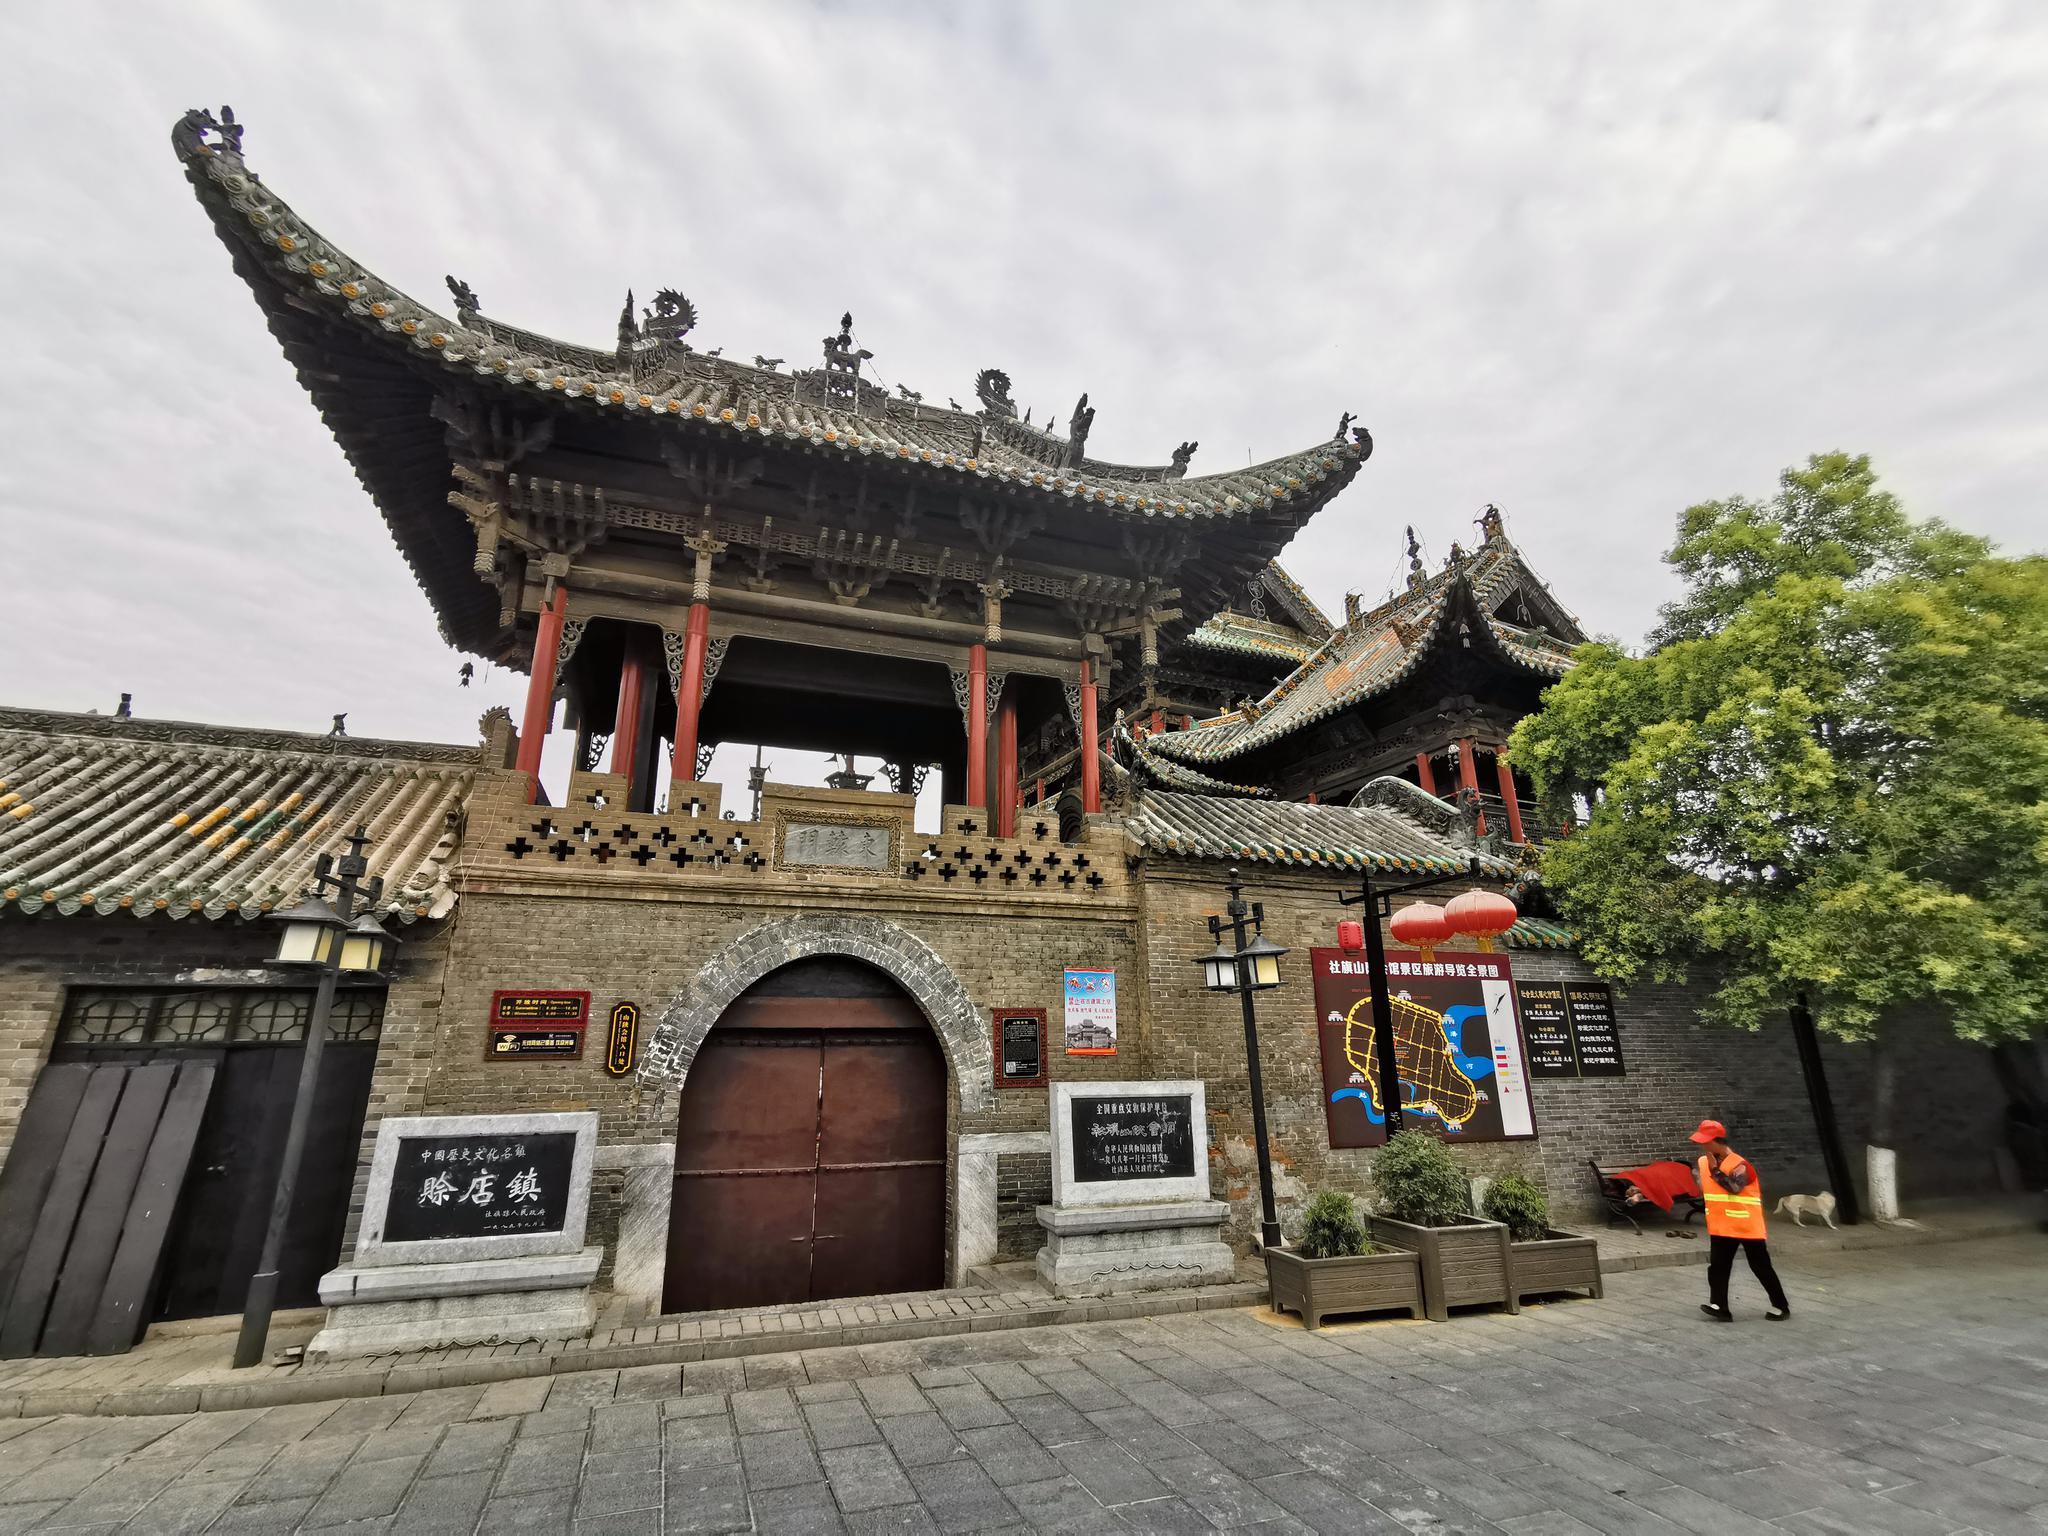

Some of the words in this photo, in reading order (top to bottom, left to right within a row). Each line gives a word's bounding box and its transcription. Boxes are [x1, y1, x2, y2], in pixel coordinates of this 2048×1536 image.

[1328, 960, 1499, 978] 社旗山馆景区旅游导览全景图
[1096, 1102, 1168, 1115] 全国重点文物保护单位
